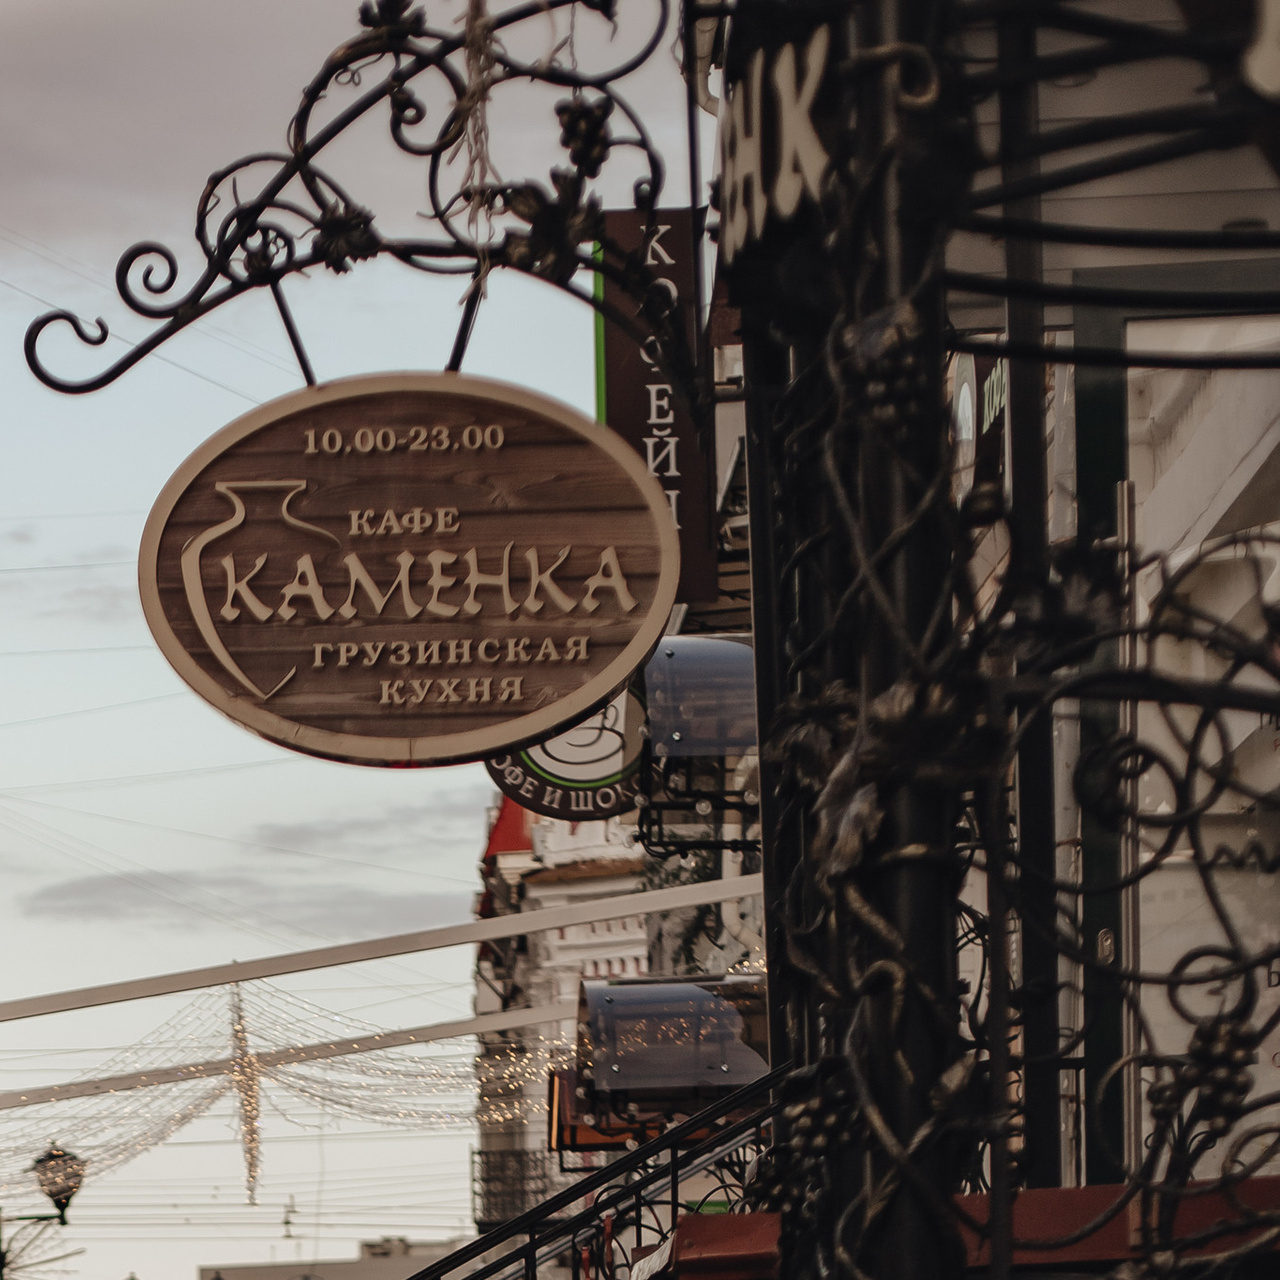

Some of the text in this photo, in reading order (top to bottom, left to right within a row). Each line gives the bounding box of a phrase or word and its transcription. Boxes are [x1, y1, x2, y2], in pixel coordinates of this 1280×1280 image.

[304, 423, 506, 455] 10.00-23.00
[347, 506, 462, 537] КАФЕ
[219, 540, 640, 623] КАМЕНКА
[311, 635, 591, 669] ГРУЗИНСКАЯ
[378, 676, 525, 705] КУХНЯ
[541, 785, 565, 810] И
